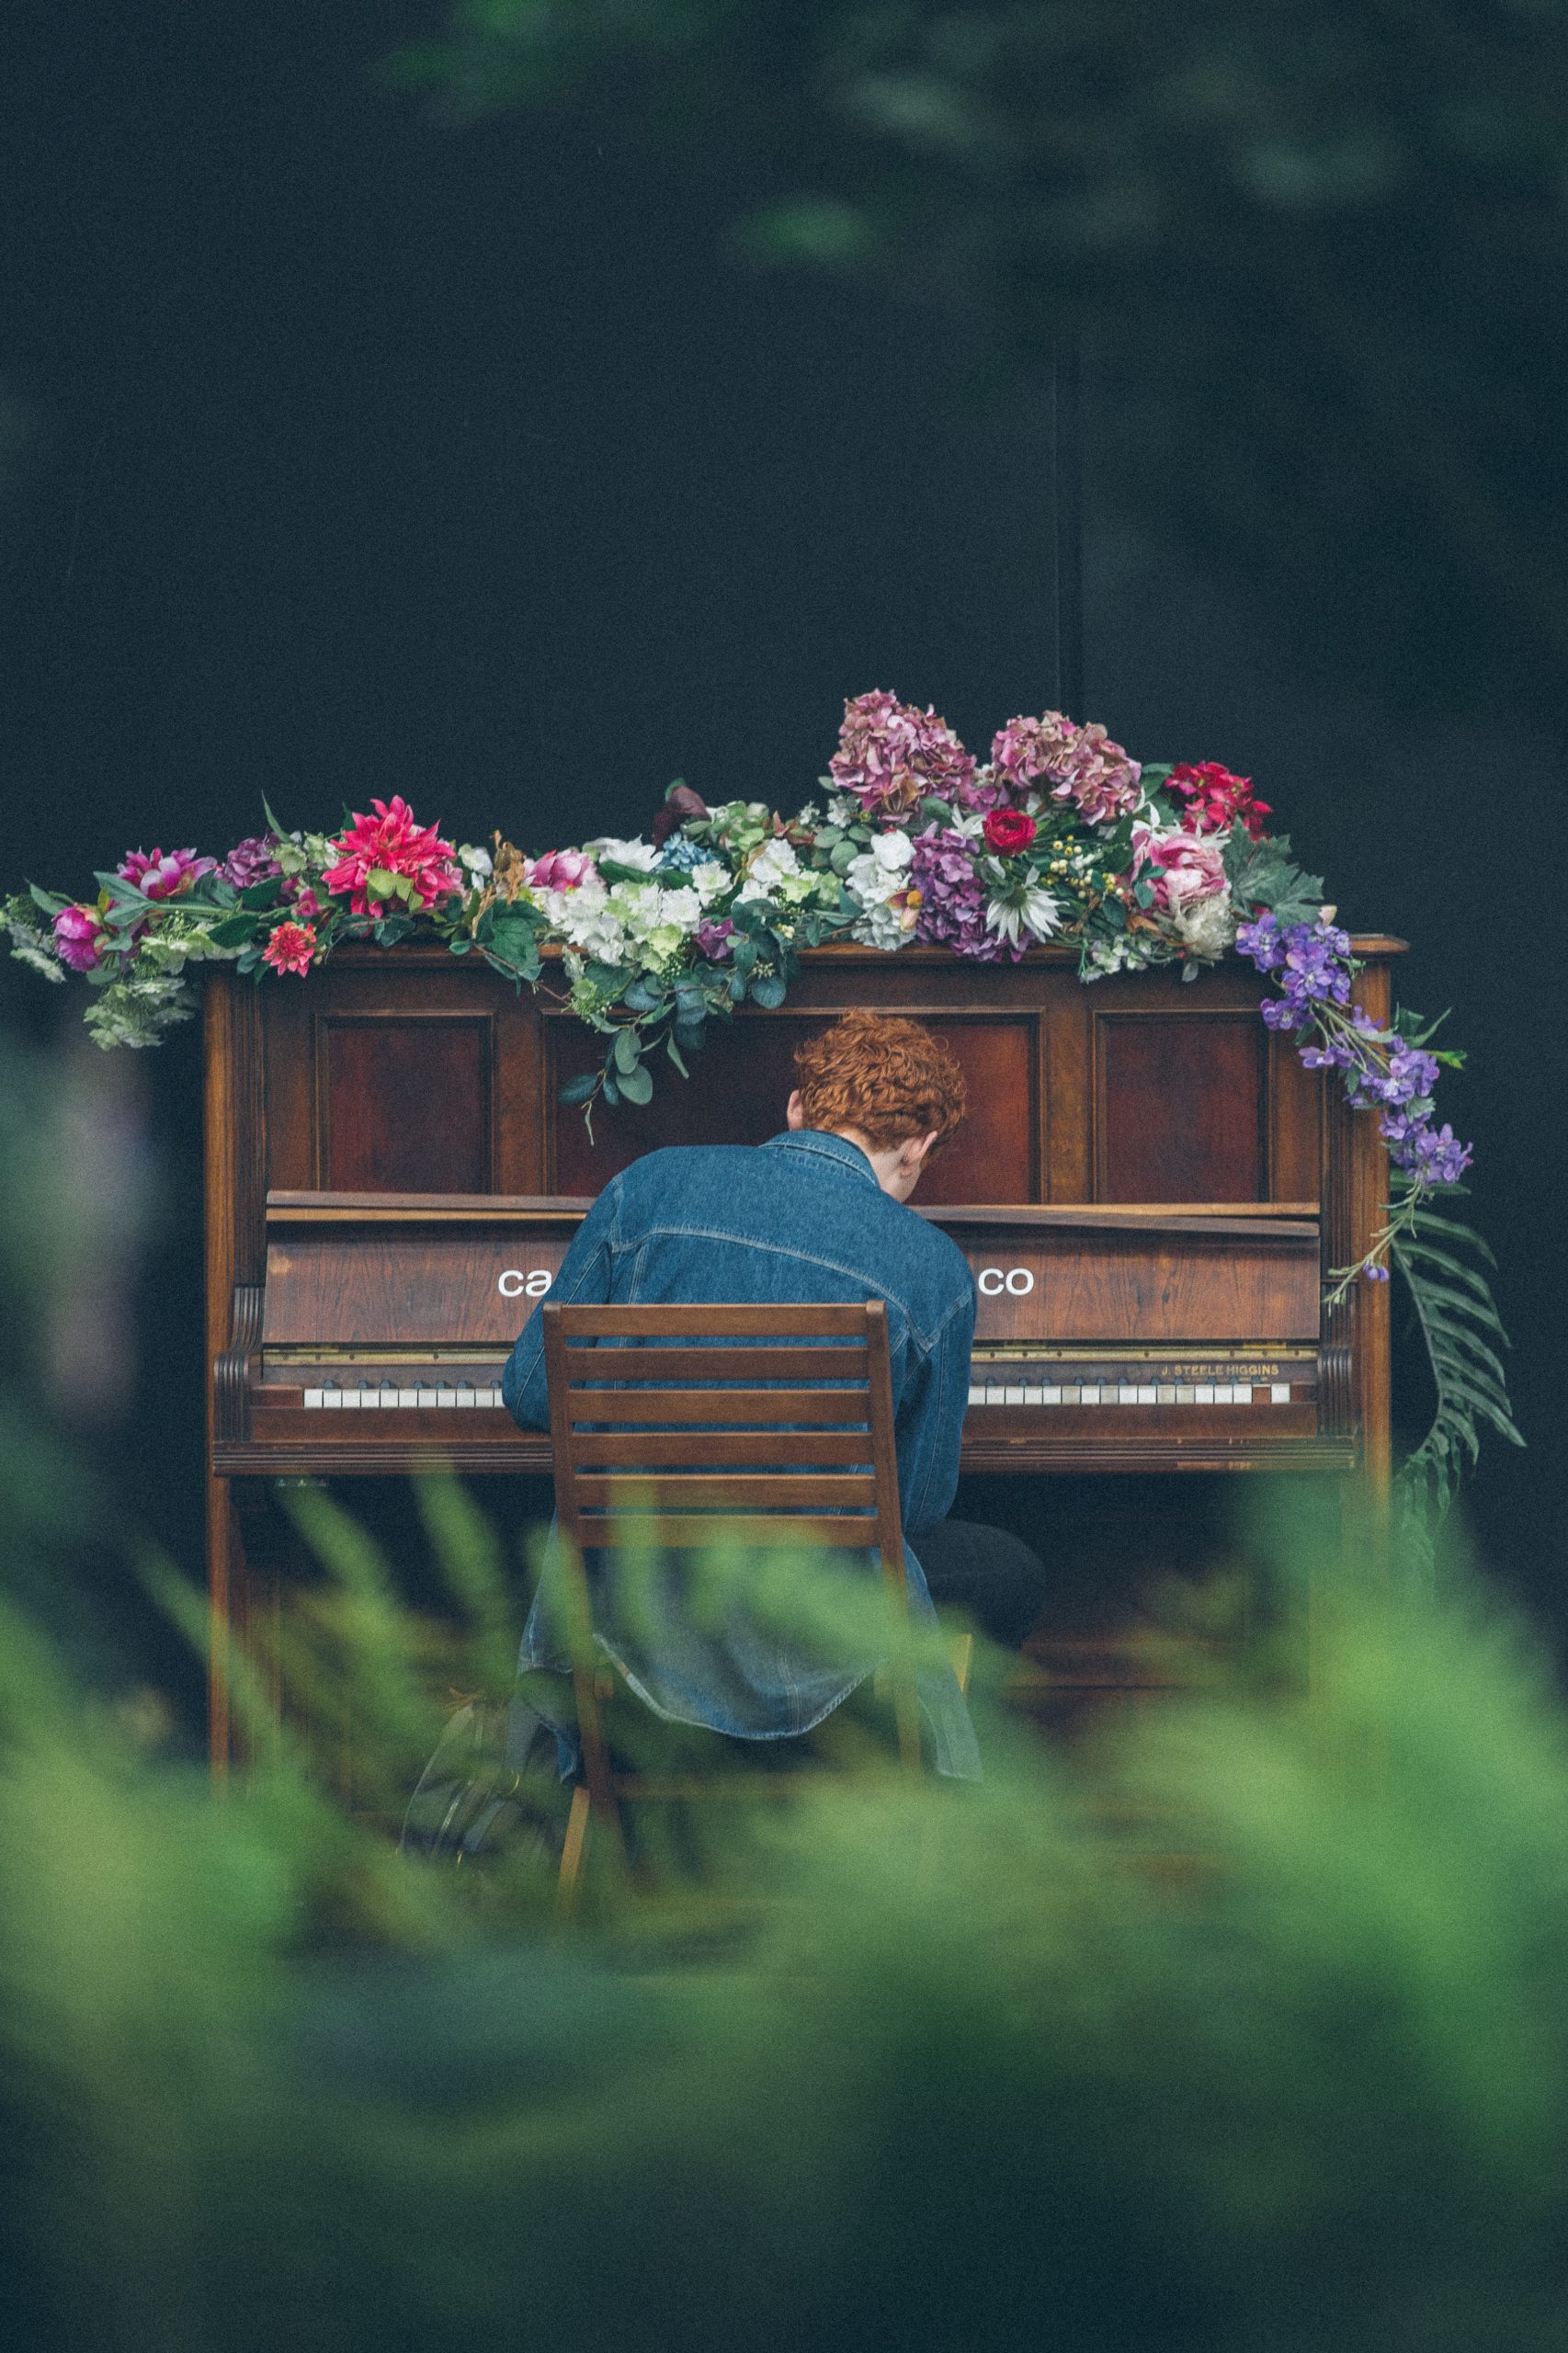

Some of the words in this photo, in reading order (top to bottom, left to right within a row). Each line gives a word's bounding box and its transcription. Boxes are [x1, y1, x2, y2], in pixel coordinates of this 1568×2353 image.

[1161, 1365, 1171, 1376] J.
[1174, 1365, 1224, 1376] STEELE
[1226, 1364, 1279, 1376] HIGGINS
